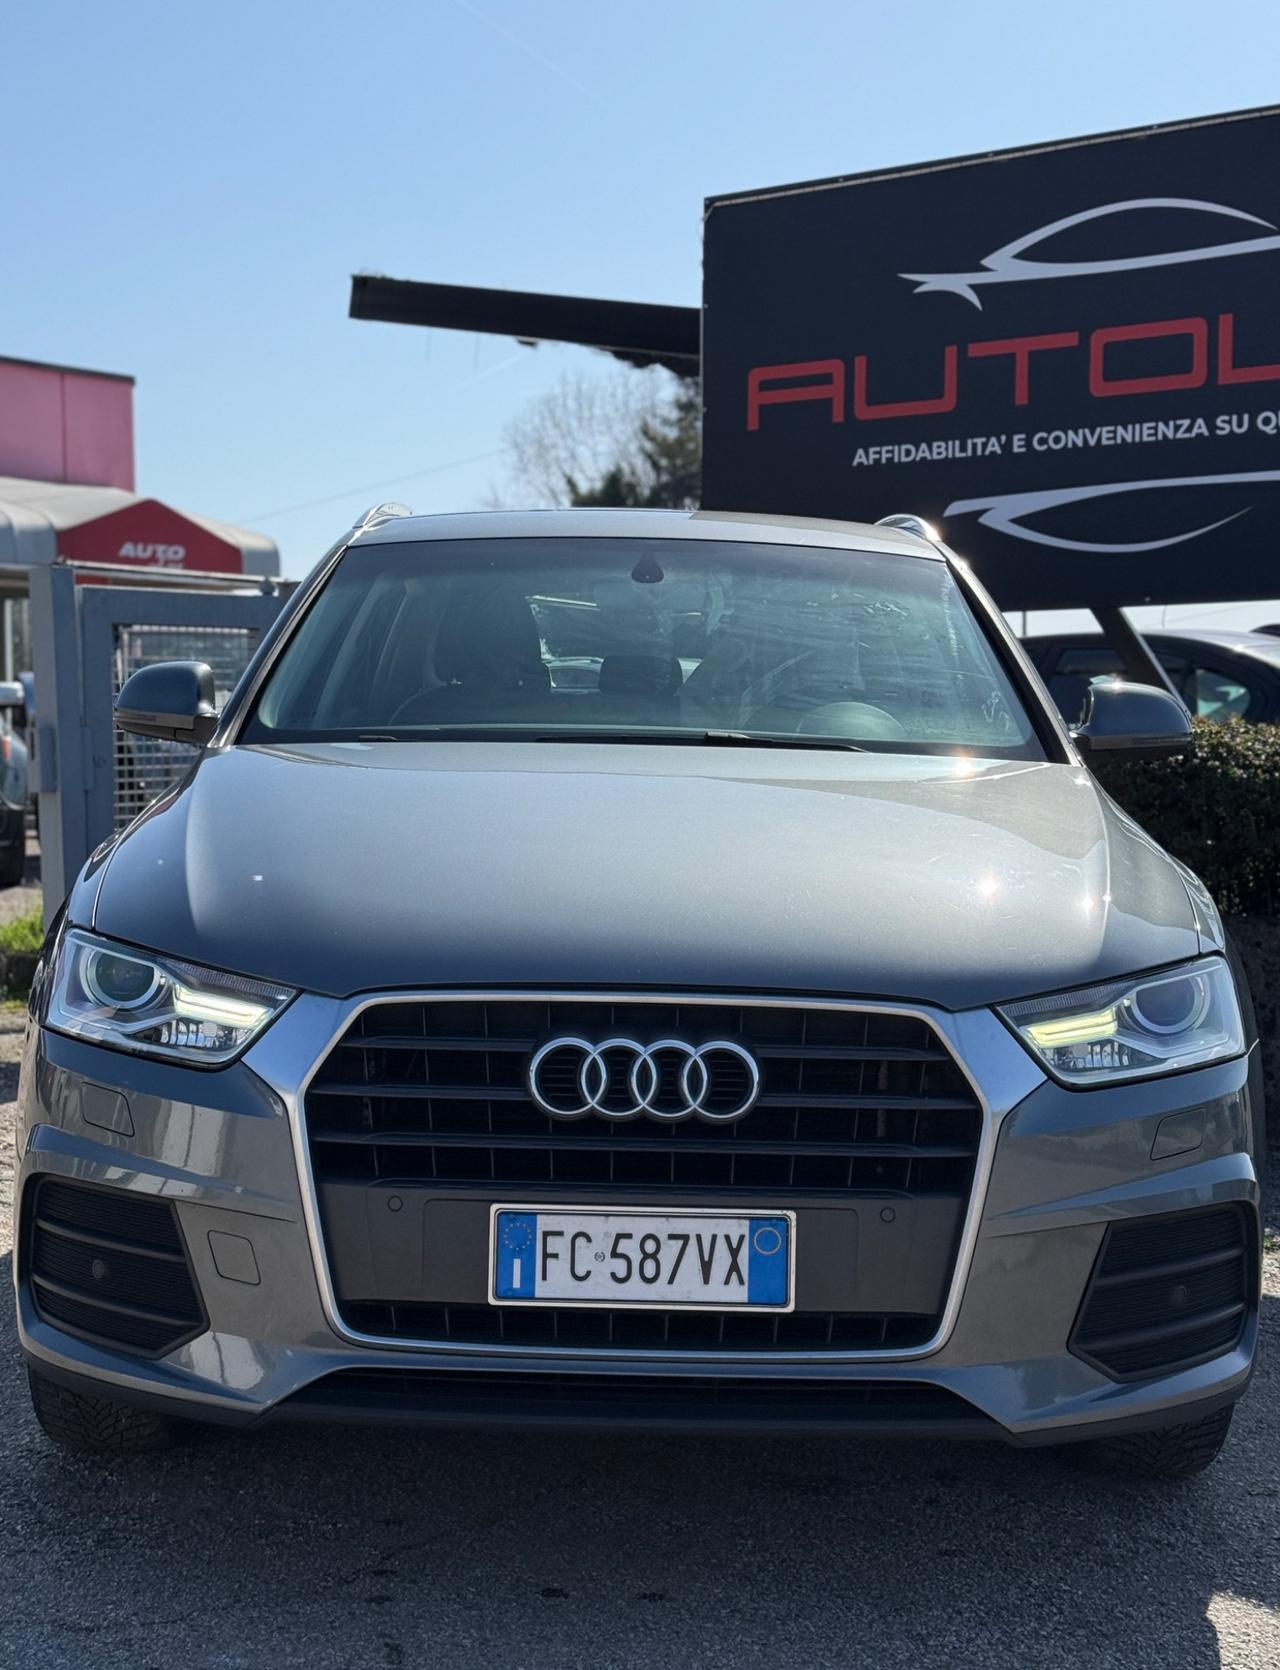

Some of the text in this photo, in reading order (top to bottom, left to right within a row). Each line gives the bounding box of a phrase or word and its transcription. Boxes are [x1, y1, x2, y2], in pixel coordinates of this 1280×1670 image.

[1012, 434, 1027, 453] E
[1032, 417, 1210, 451] CONVENIENZA
[1215, 413, 1249, 436] SU
[1256, 411, 1280, 434] Q
[119, 542, 186, 560] AUTO
